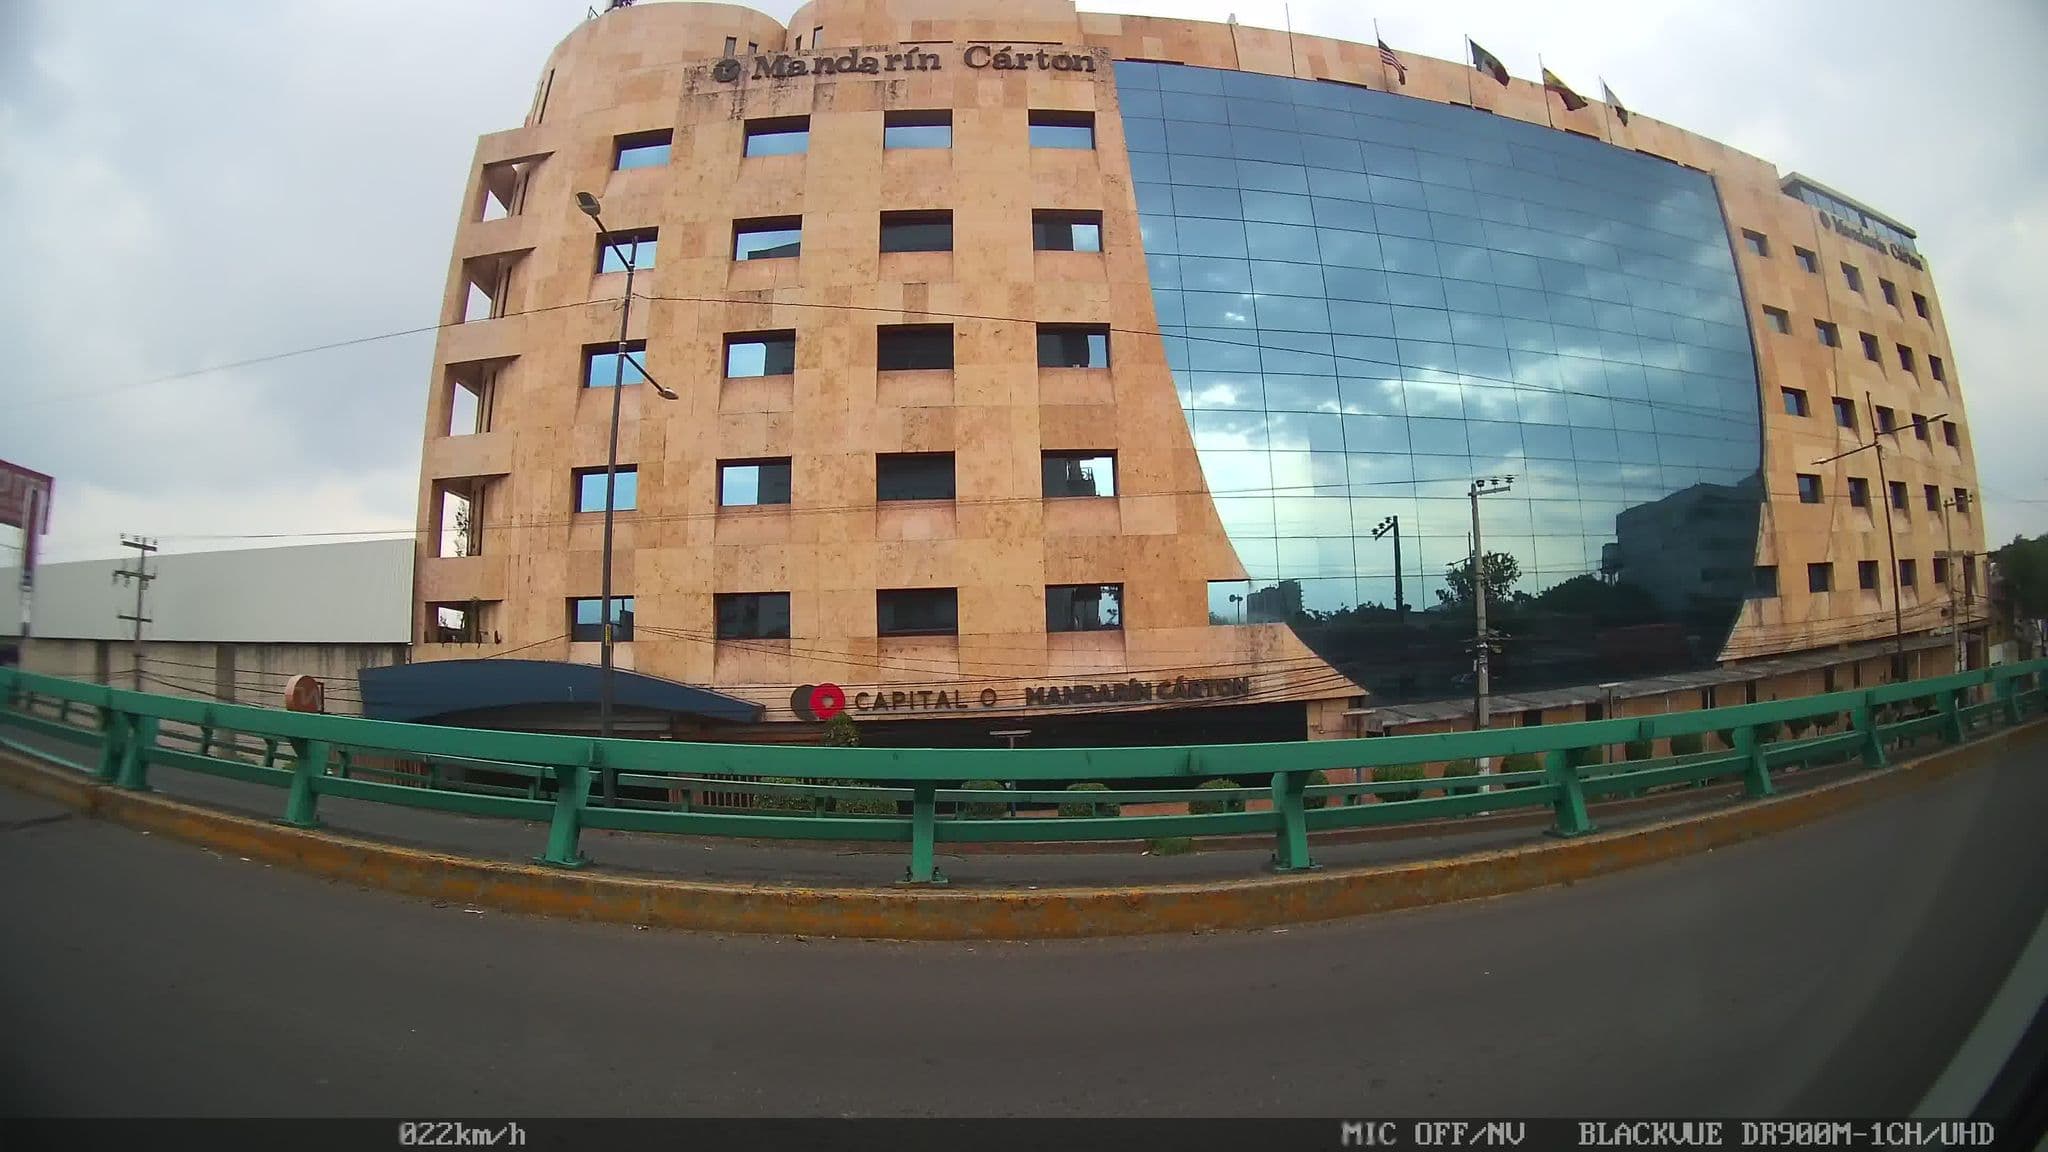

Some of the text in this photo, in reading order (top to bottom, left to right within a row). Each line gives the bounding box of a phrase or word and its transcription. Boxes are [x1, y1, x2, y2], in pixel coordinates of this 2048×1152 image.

[751, 45, 1097, 80] Mandarín Cárton
[855, 687, 997, 711] CAPITAL O
[1025, 678, 1152, 706] MANDARÍN
